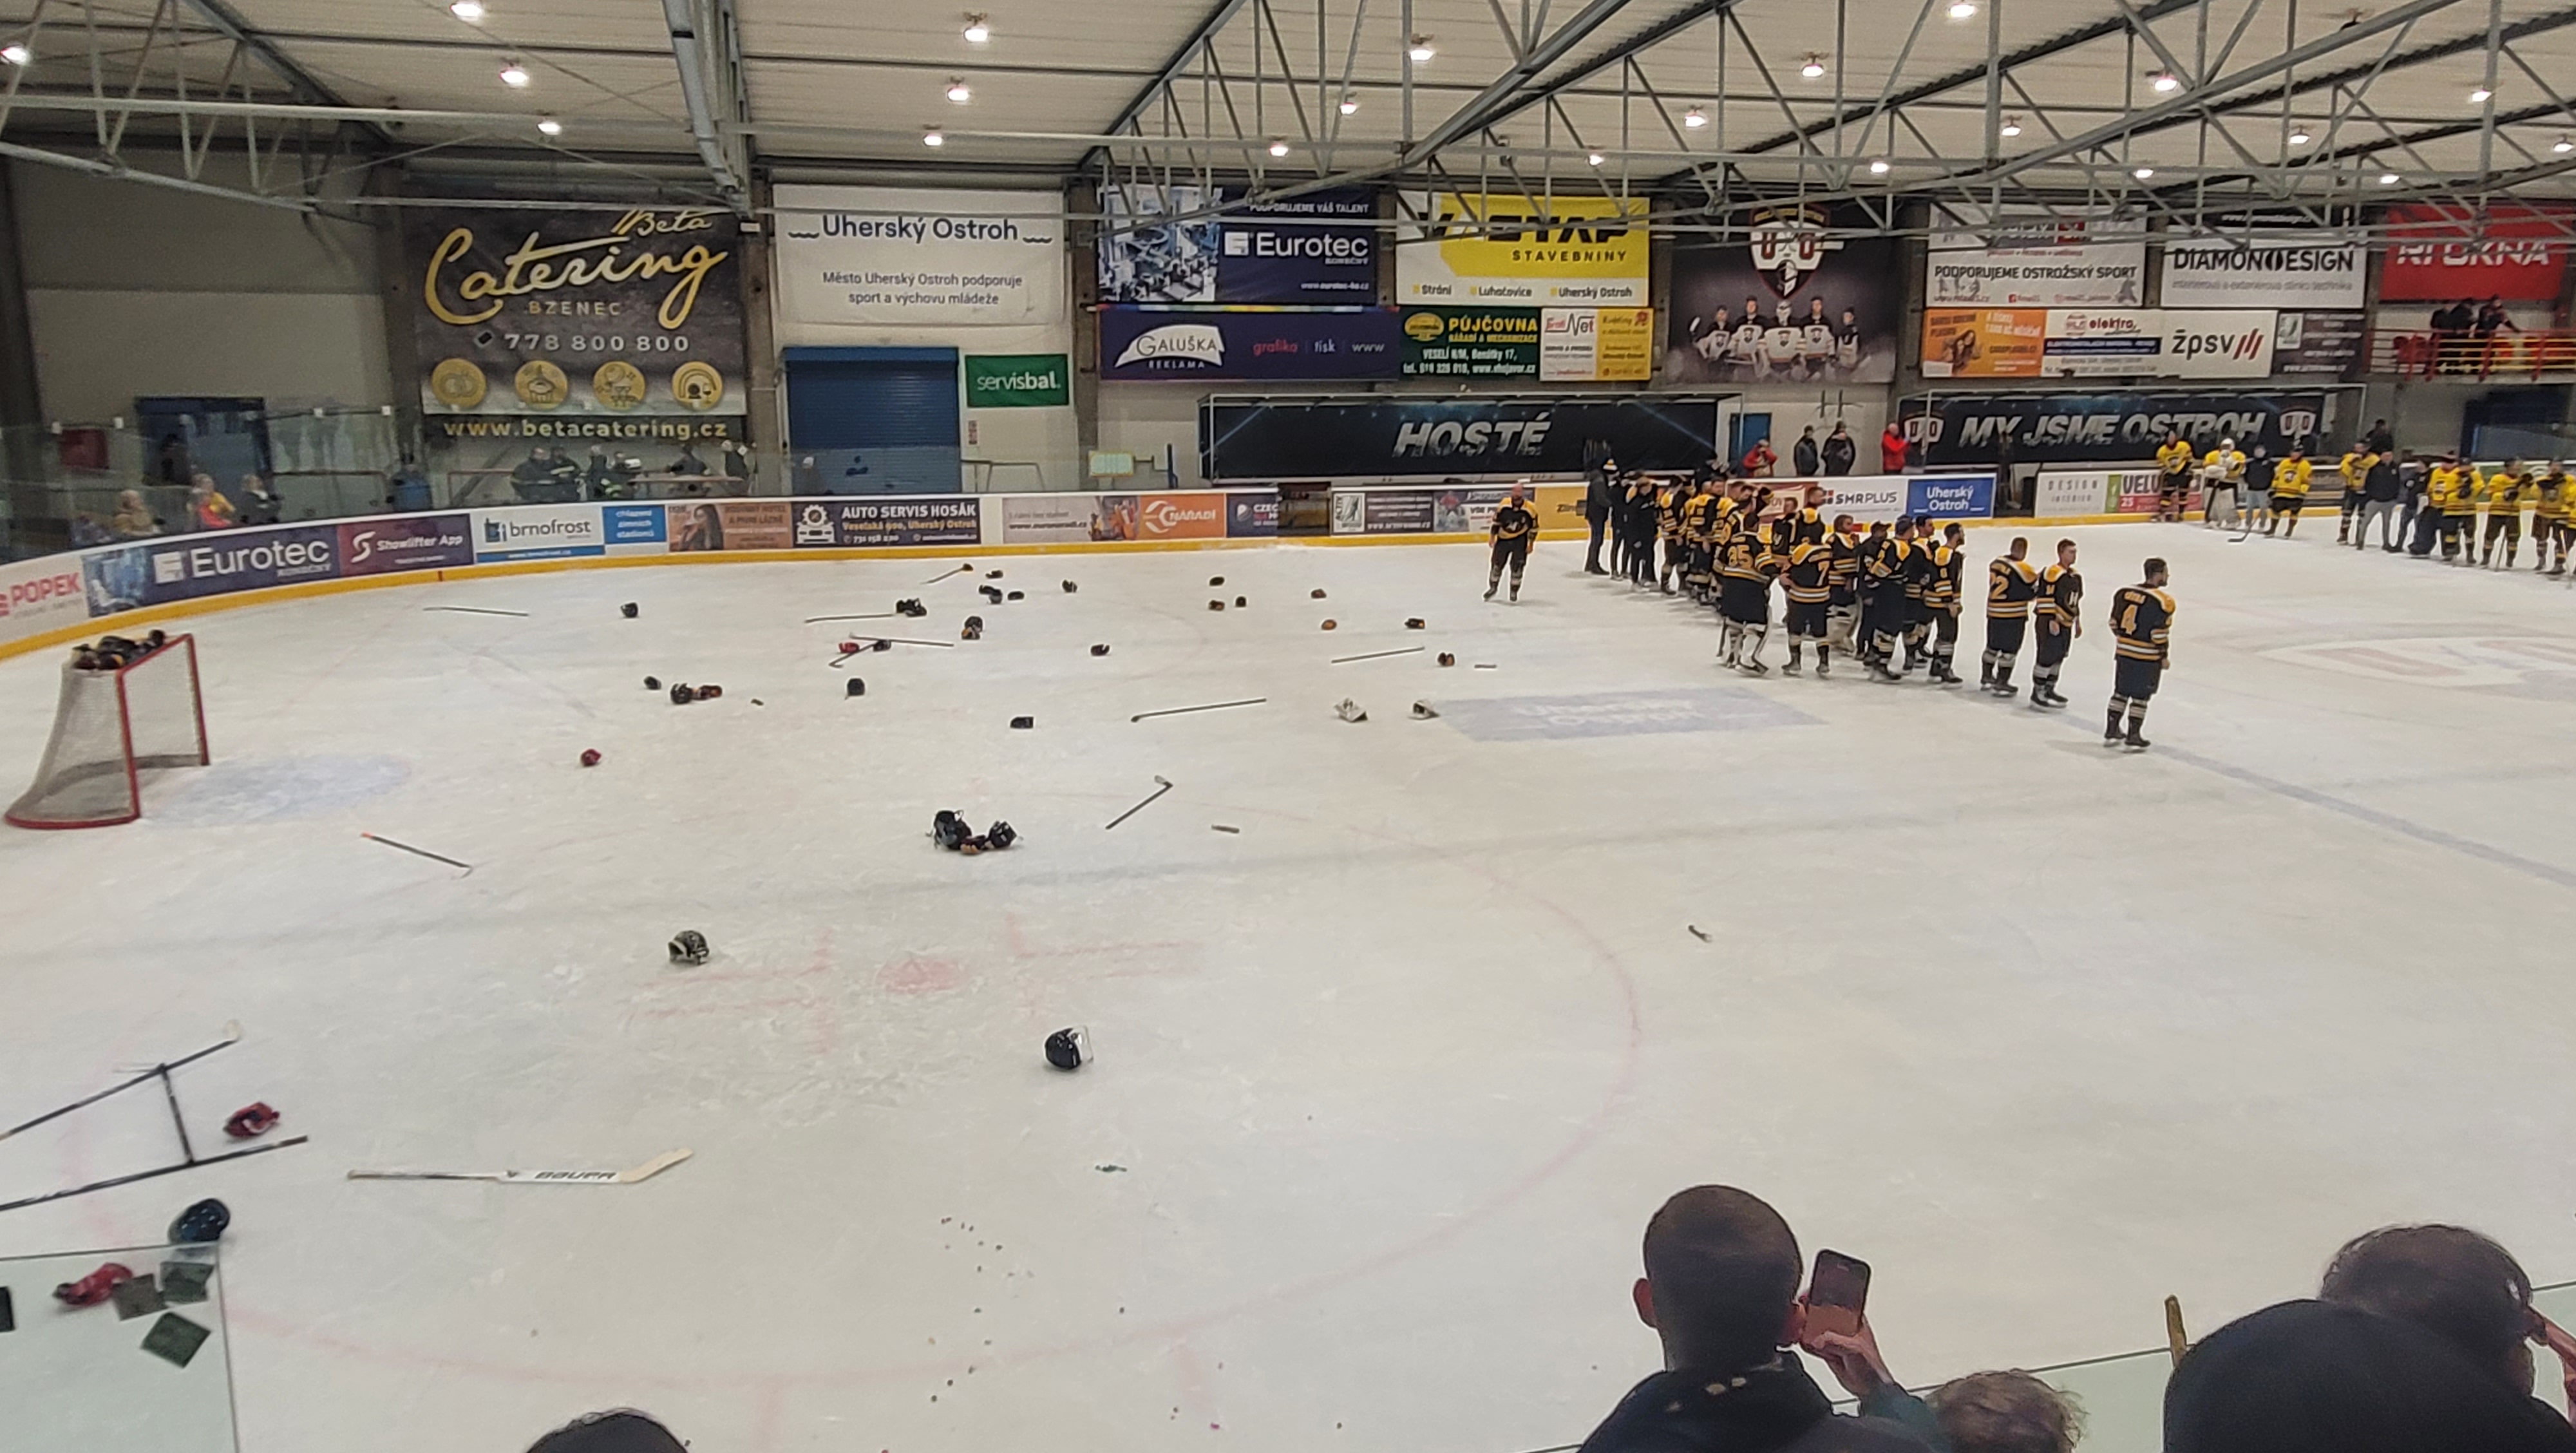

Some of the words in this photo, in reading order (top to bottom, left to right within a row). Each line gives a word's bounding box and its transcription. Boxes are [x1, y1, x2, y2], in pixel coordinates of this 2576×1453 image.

[1336, 204, 1369, 213] TALENT
[822, 214, 926, 243] Uherský
[933, 217, 1018, 240] Ostroh
[1256, 231, 1368, 257] Eurotec
[1512, 249, 1627, 262] STAVEBNINY
[425, 227, 728, 330] Catering
[823, 271, 862, 284] Město
[866, 272, 915, 287] Uherský
[918, 273, 959, 285] Ostroh
[962, 274, 1023, 289] podporuje
[1935, 265, 2019, 281] PODPORUJEME
[2022, 264, 2094, 280] OSTROŽSKÝ
[2096, 265, 2137, 279] SPORT
[528, 301, 621, 316] BZENEC
[849, 292, 880, 305] sport
[884, 295, 891, 304] a
[895, 292, 945, 307] výchovu
[949, 293, 999, 305] mládeže
[504, 334, 560, 351] 778
[571, 334, 625, 351] 800
[636, 334, 689, 352] 800
[1136, 334, 1218, 356] GALUŠKA
[1253, 338, 1298, 356] grafika
[1314, 339, 1336, 354] tisk
[1352, 343, 1385, 353] www
[1148, 359, 1206, 369] REKLAMA
[444, 419, 728, 441] www.betacatering.cz
[1395, 413, 1550, 457] HOSTÉ
[1959, 415, 2022, 447] MY
[2023, 414, 2121, 446] JSME
[2123, 412, 2266, 444] OSTROH
[1926, 484, 1974, 500] Uherský
[842, 506, 877, 519] AUTO
[880, 505, 928, 518] SERVIS
[931, 502, 976, 517] HOSÁK
[1928, 499, 1969, 511] Ostroh
[510, 518, 592, 538] brnofrost
[439, 534, 463, 547] App
[191, 540, 330, 578] Eurotec
[10, 571, 82, 607] POPEK
[2120, 603, 2138, 635] 4
